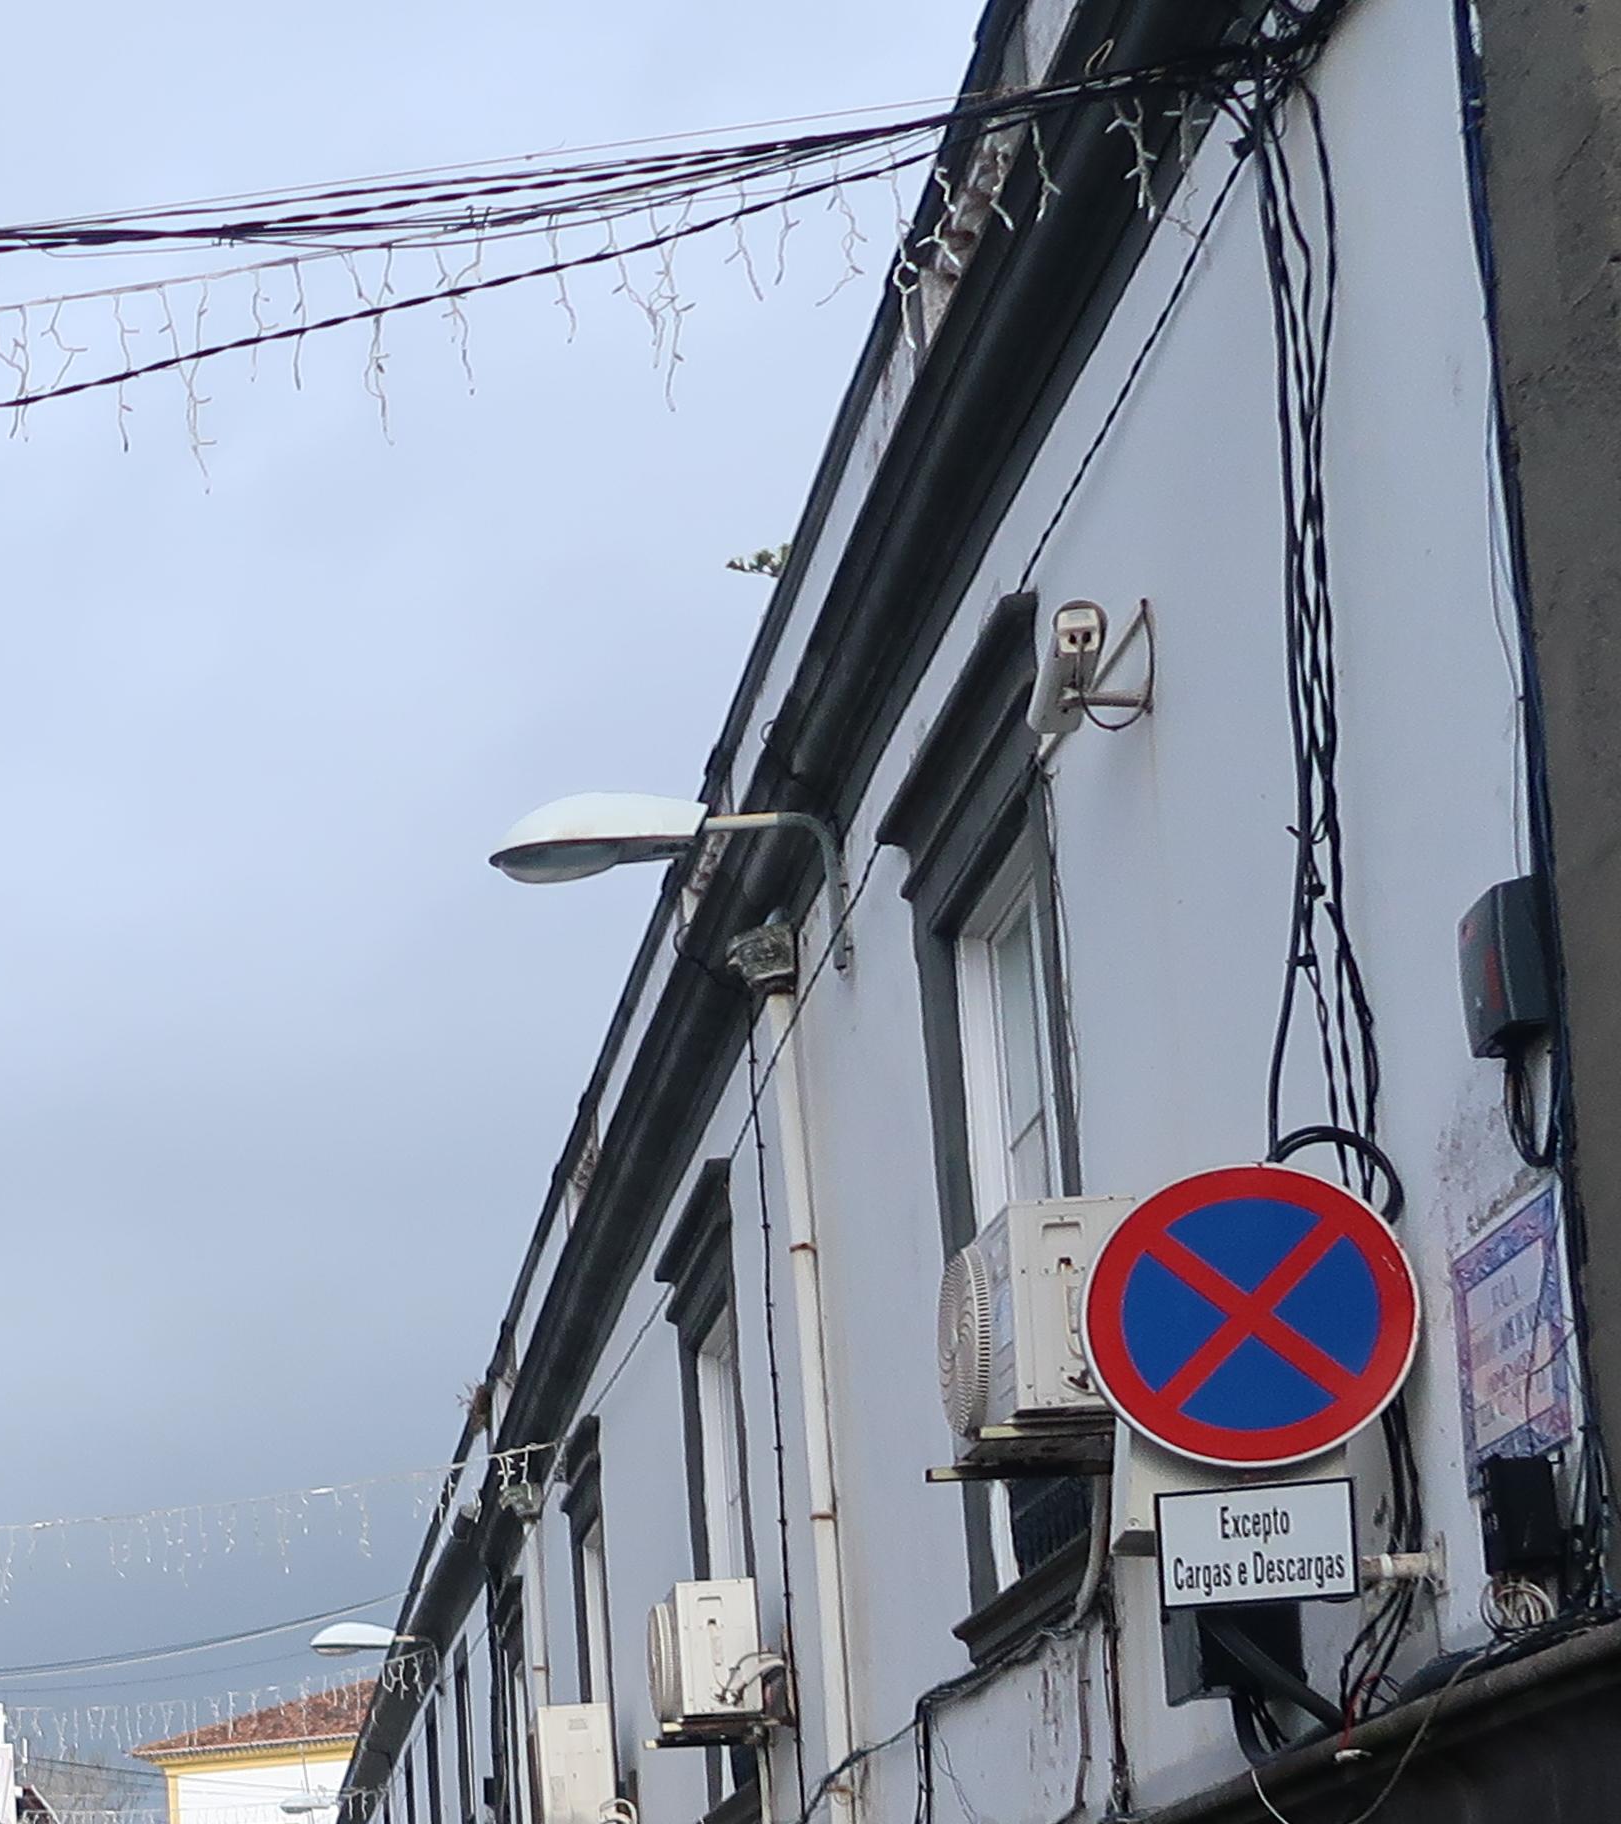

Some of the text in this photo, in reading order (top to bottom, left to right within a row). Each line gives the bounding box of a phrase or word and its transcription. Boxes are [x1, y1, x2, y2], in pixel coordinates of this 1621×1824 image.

[1219, 1505, 1292, 1544] Excepto
[1173, 1551, 1346, 1597] Cargas e Descargas
